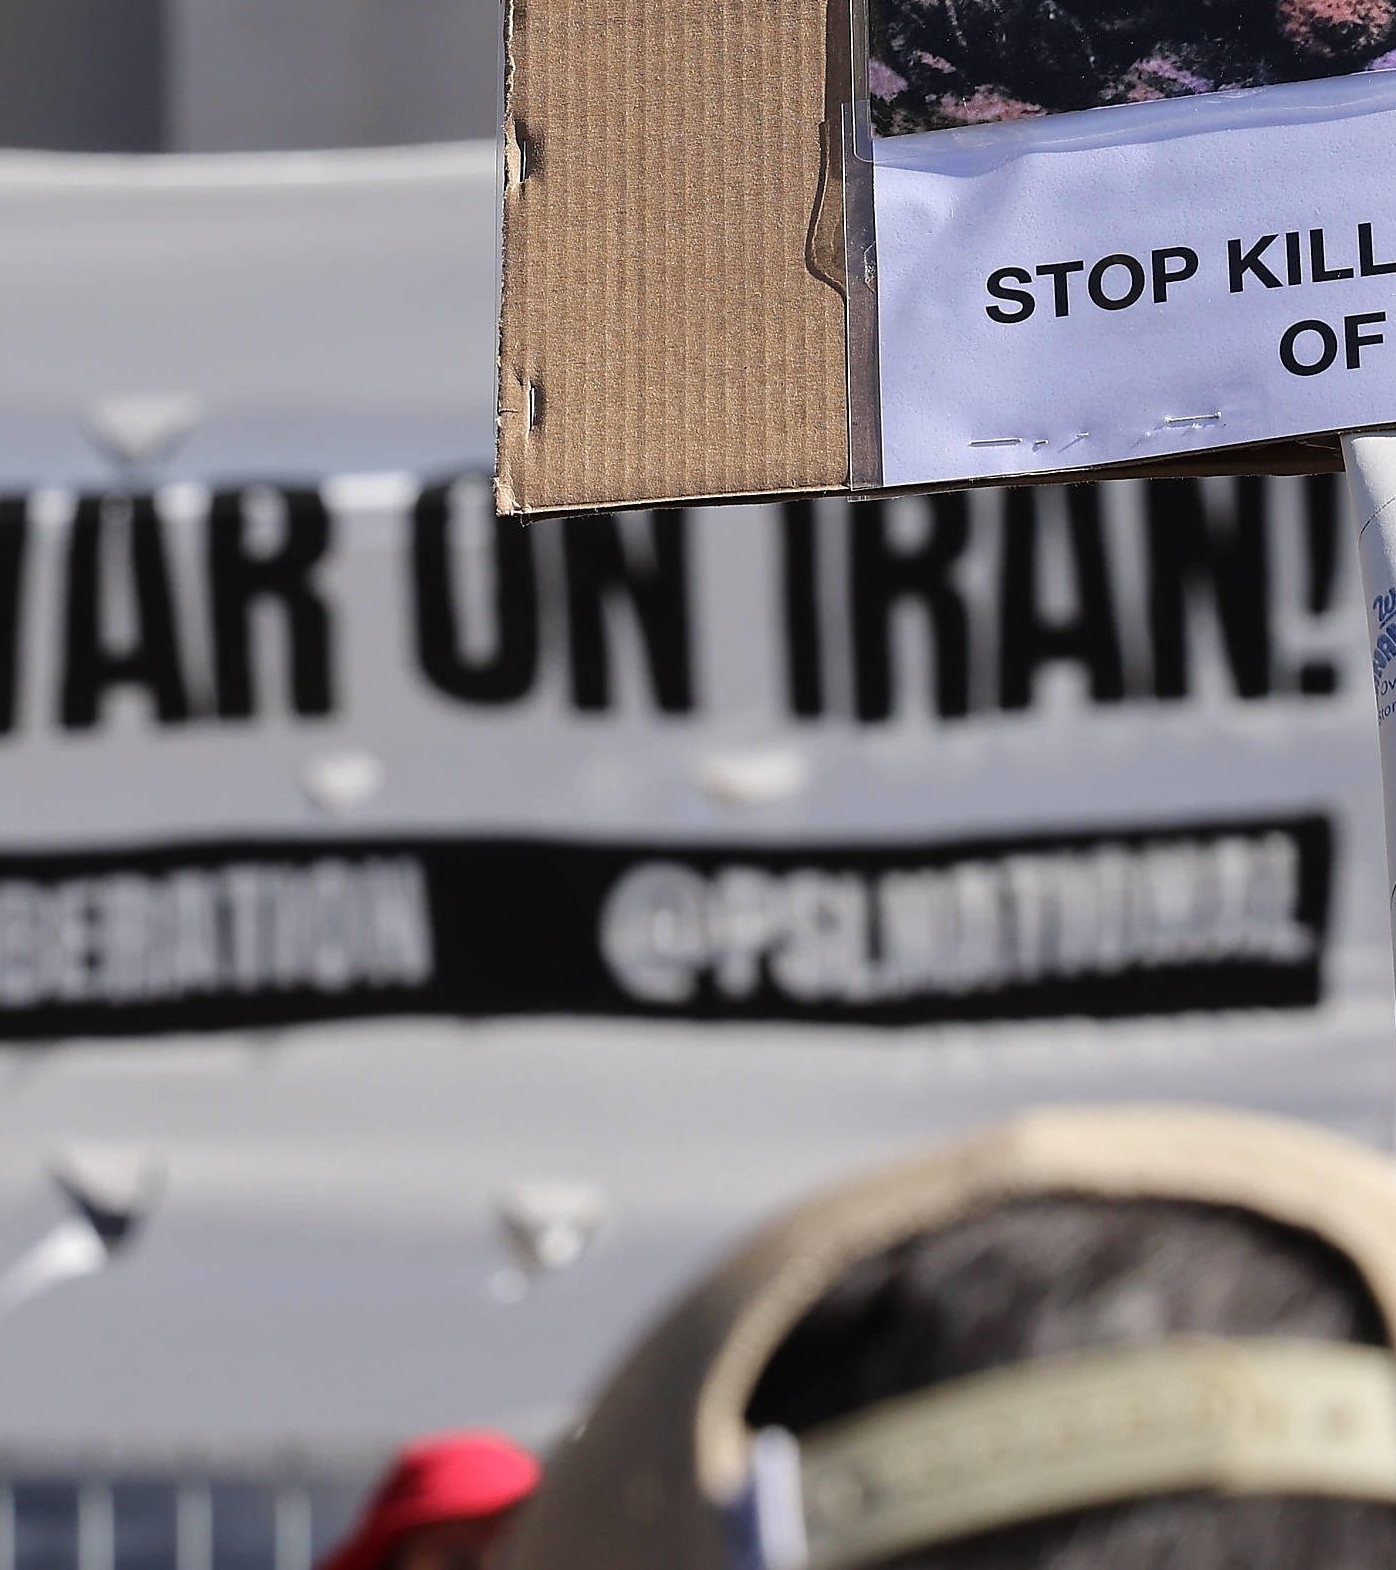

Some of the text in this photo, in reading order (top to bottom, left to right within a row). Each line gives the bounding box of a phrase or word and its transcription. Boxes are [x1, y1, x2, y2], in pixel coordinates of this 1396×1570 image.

[985, 244, 1200, 323] STOP
[1278, 311, 1390, 377] OF
[409, 474, 695, 718] ON
[776, 476, 1342, 725] IRAN!
